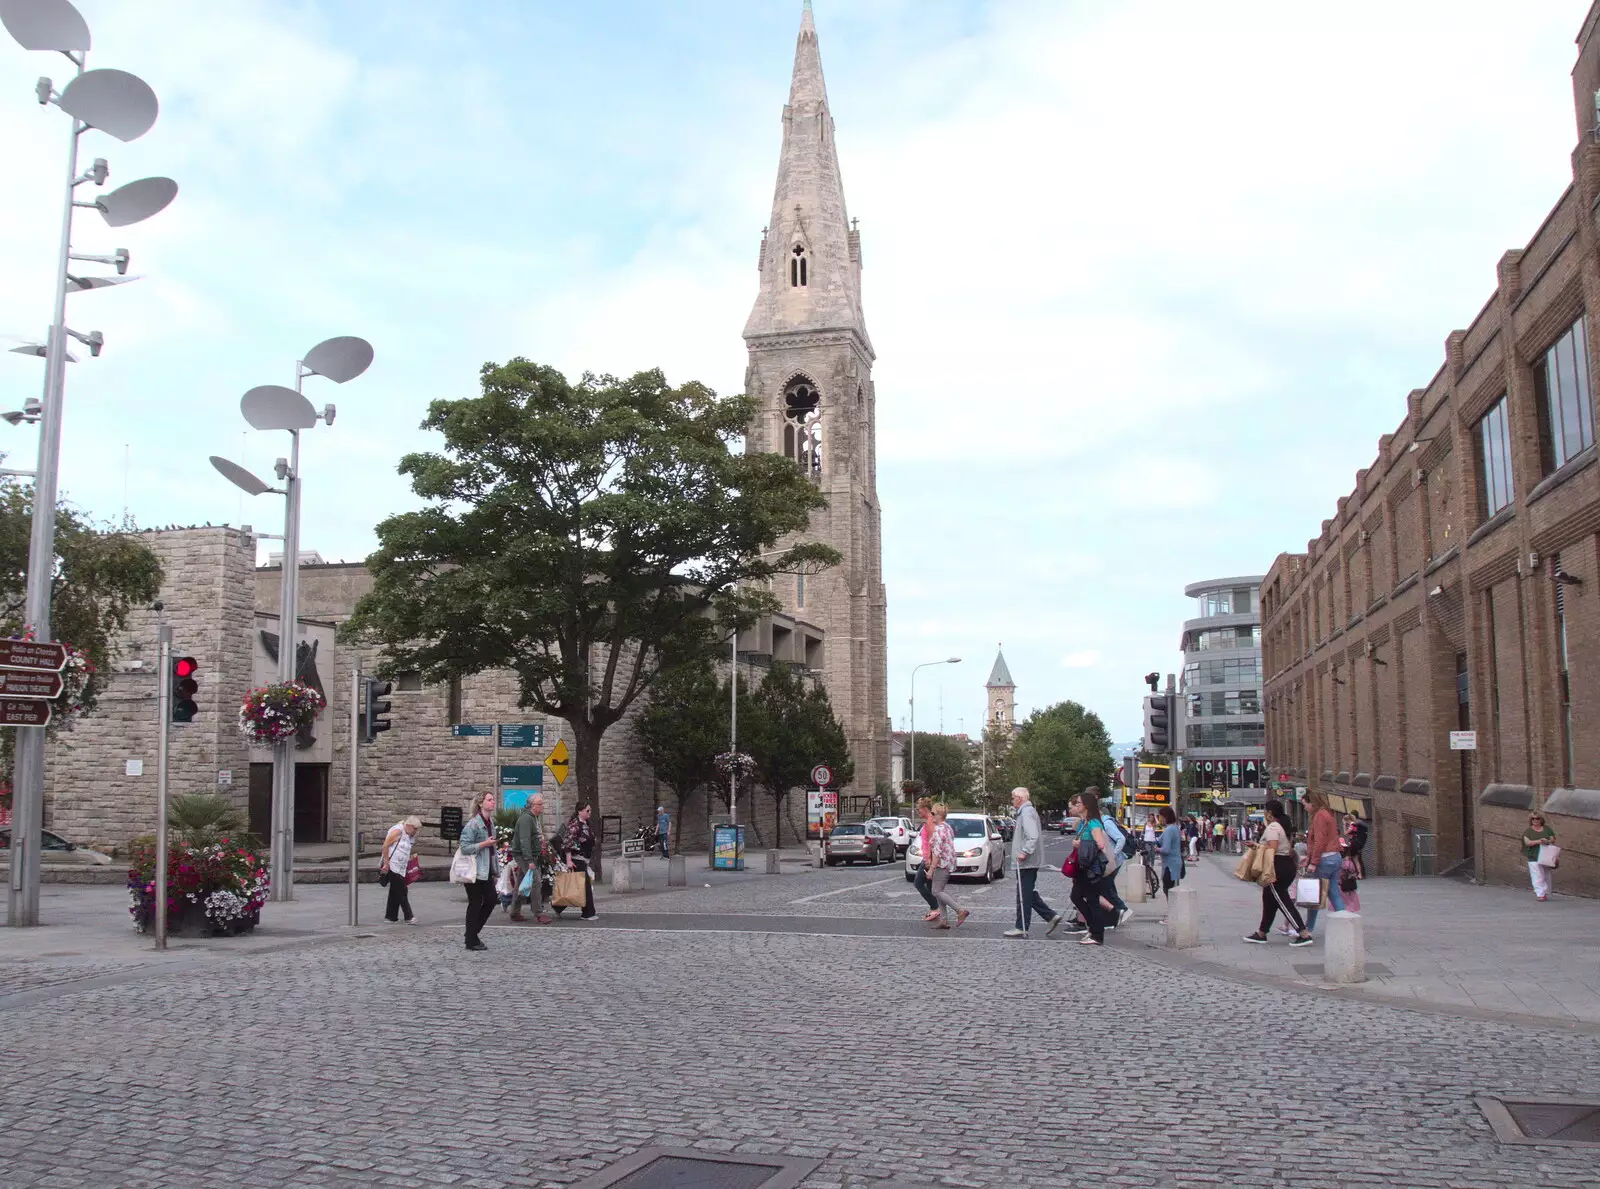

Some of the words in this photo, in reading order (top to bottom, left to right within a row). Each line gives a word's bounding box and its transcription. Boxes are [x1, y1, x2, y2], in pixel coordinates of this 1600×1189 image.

[10, 655, 38, 664] COUNTY
[39, 658, 56, 666] HALL
[6, 713, 22, 721] EAST
[24, 713, 38, 721] PIER
[818, 771, 828, 780] 50
